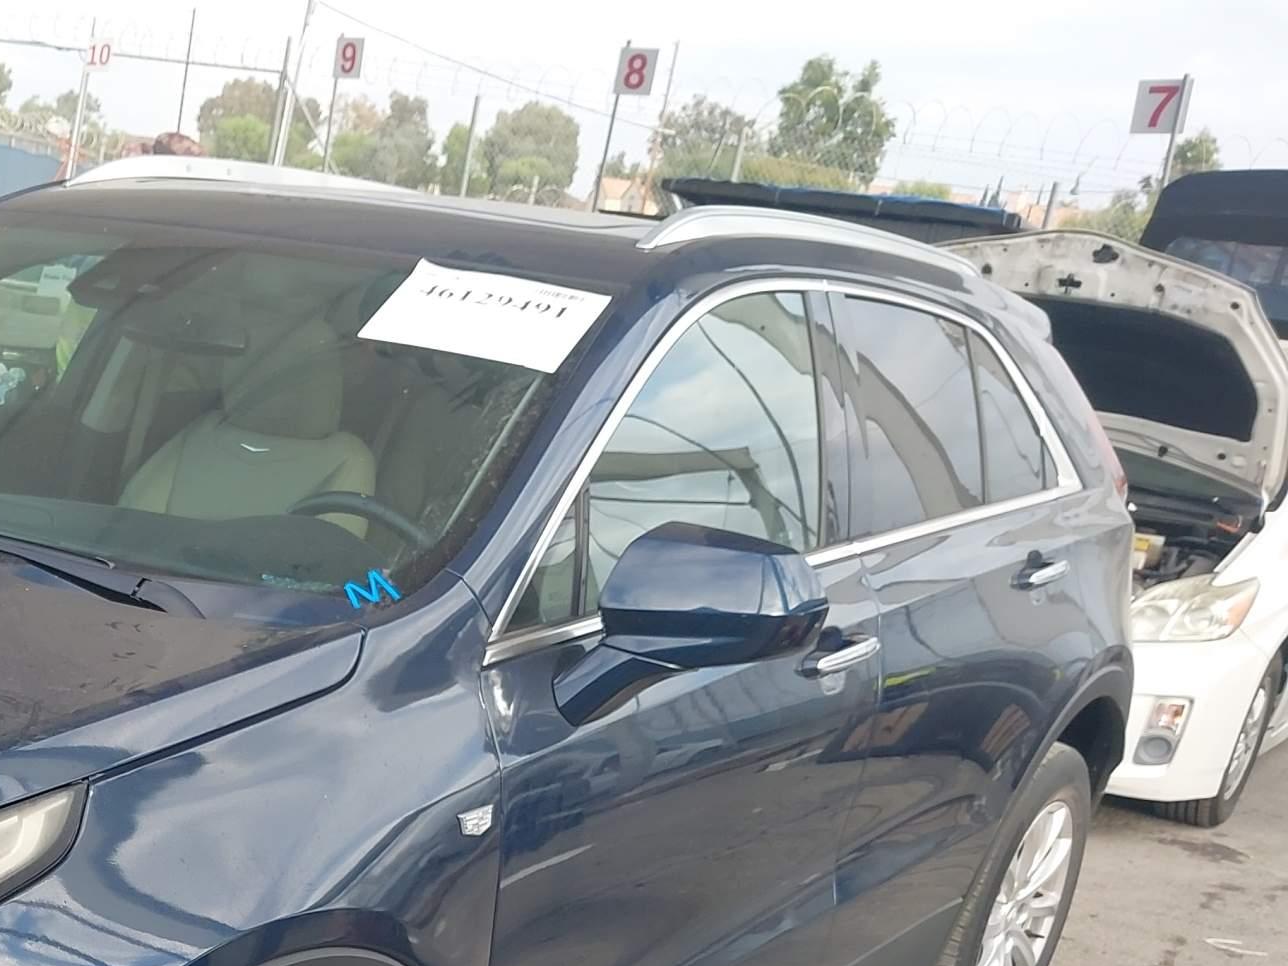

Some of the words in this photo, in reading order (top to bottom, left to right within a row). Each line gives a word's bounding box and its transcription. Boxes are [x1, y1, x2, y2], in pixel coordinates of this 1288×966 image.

[88, 43, 111, 66] 10
[341, 42, 356, 74] 9
[623, 53, 648, 90] 8
[1148, 85, 1180, 128] 7
[420, 284, 568, 319] 46129491
[344, 569, 401, 609] M
